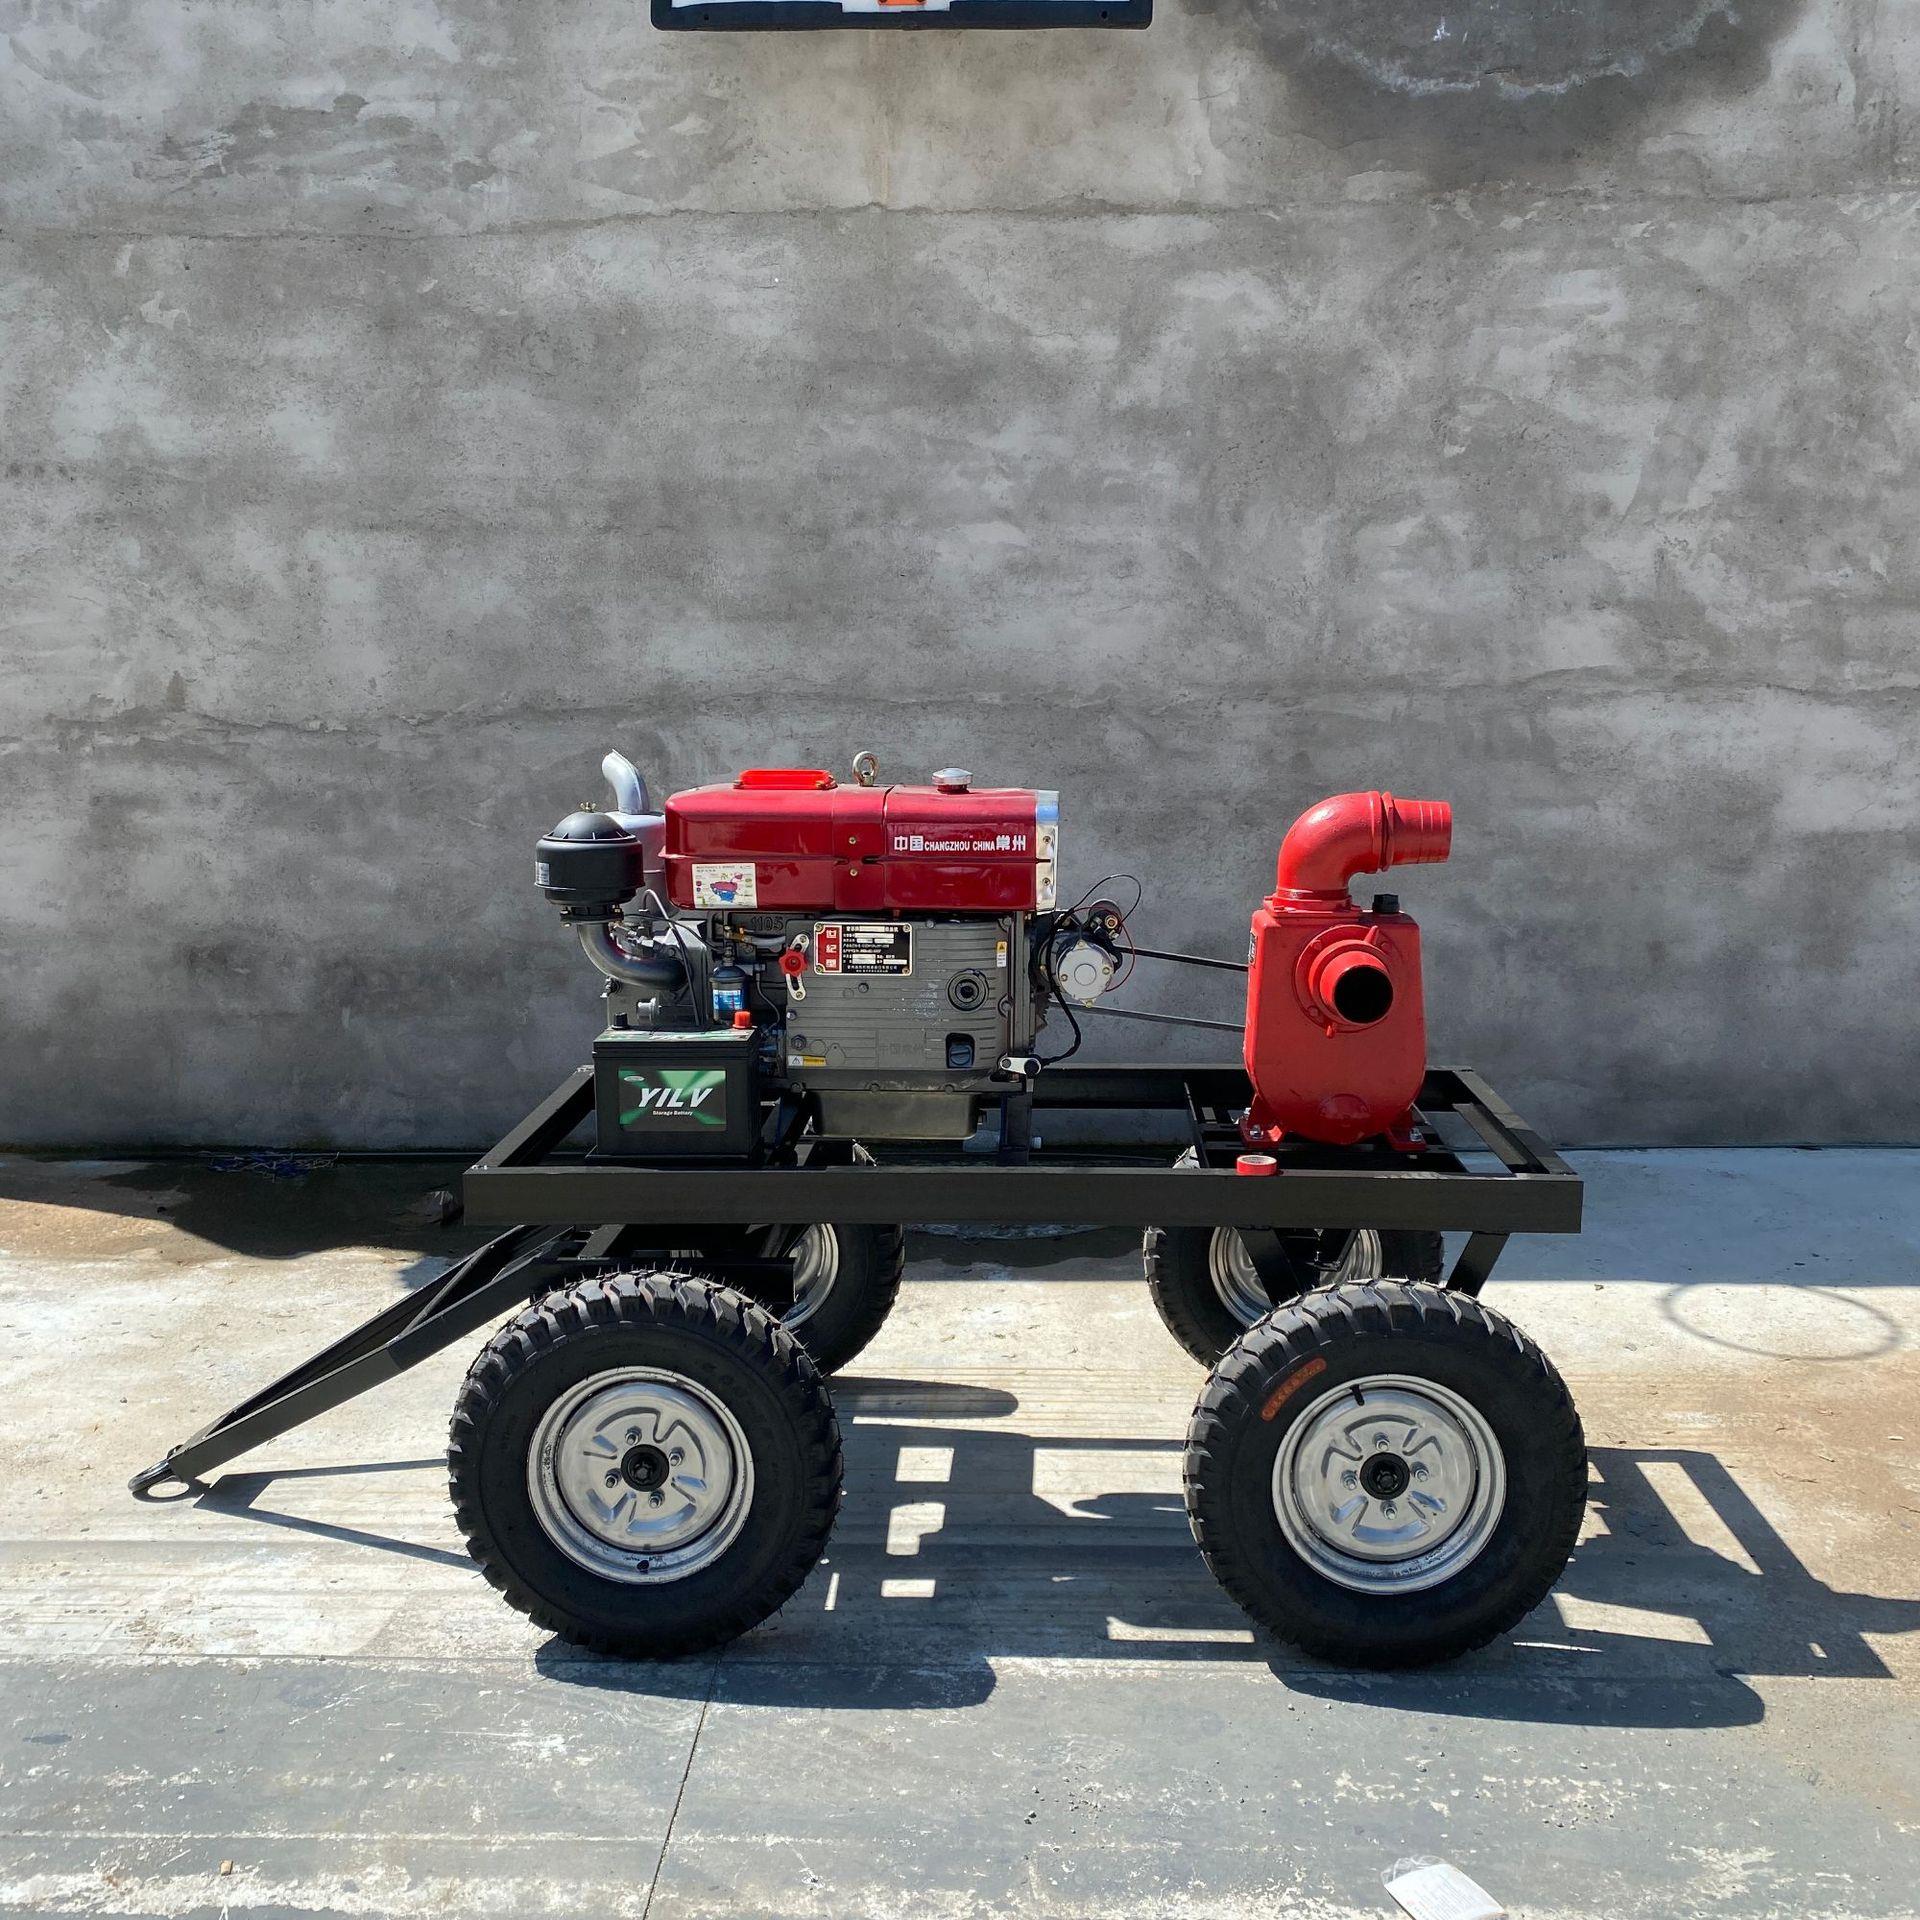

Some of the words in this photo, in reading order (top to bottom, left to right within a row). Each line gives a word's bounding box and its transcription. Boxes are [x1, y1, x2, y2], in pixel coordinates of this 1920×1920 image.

[894, 835, 924, 851] 中国
[924, 841, 970, 851] CHANGZHOU
[972, 841, 996, 851] CHINA
[638, 1088, 713, 1108] YILV
